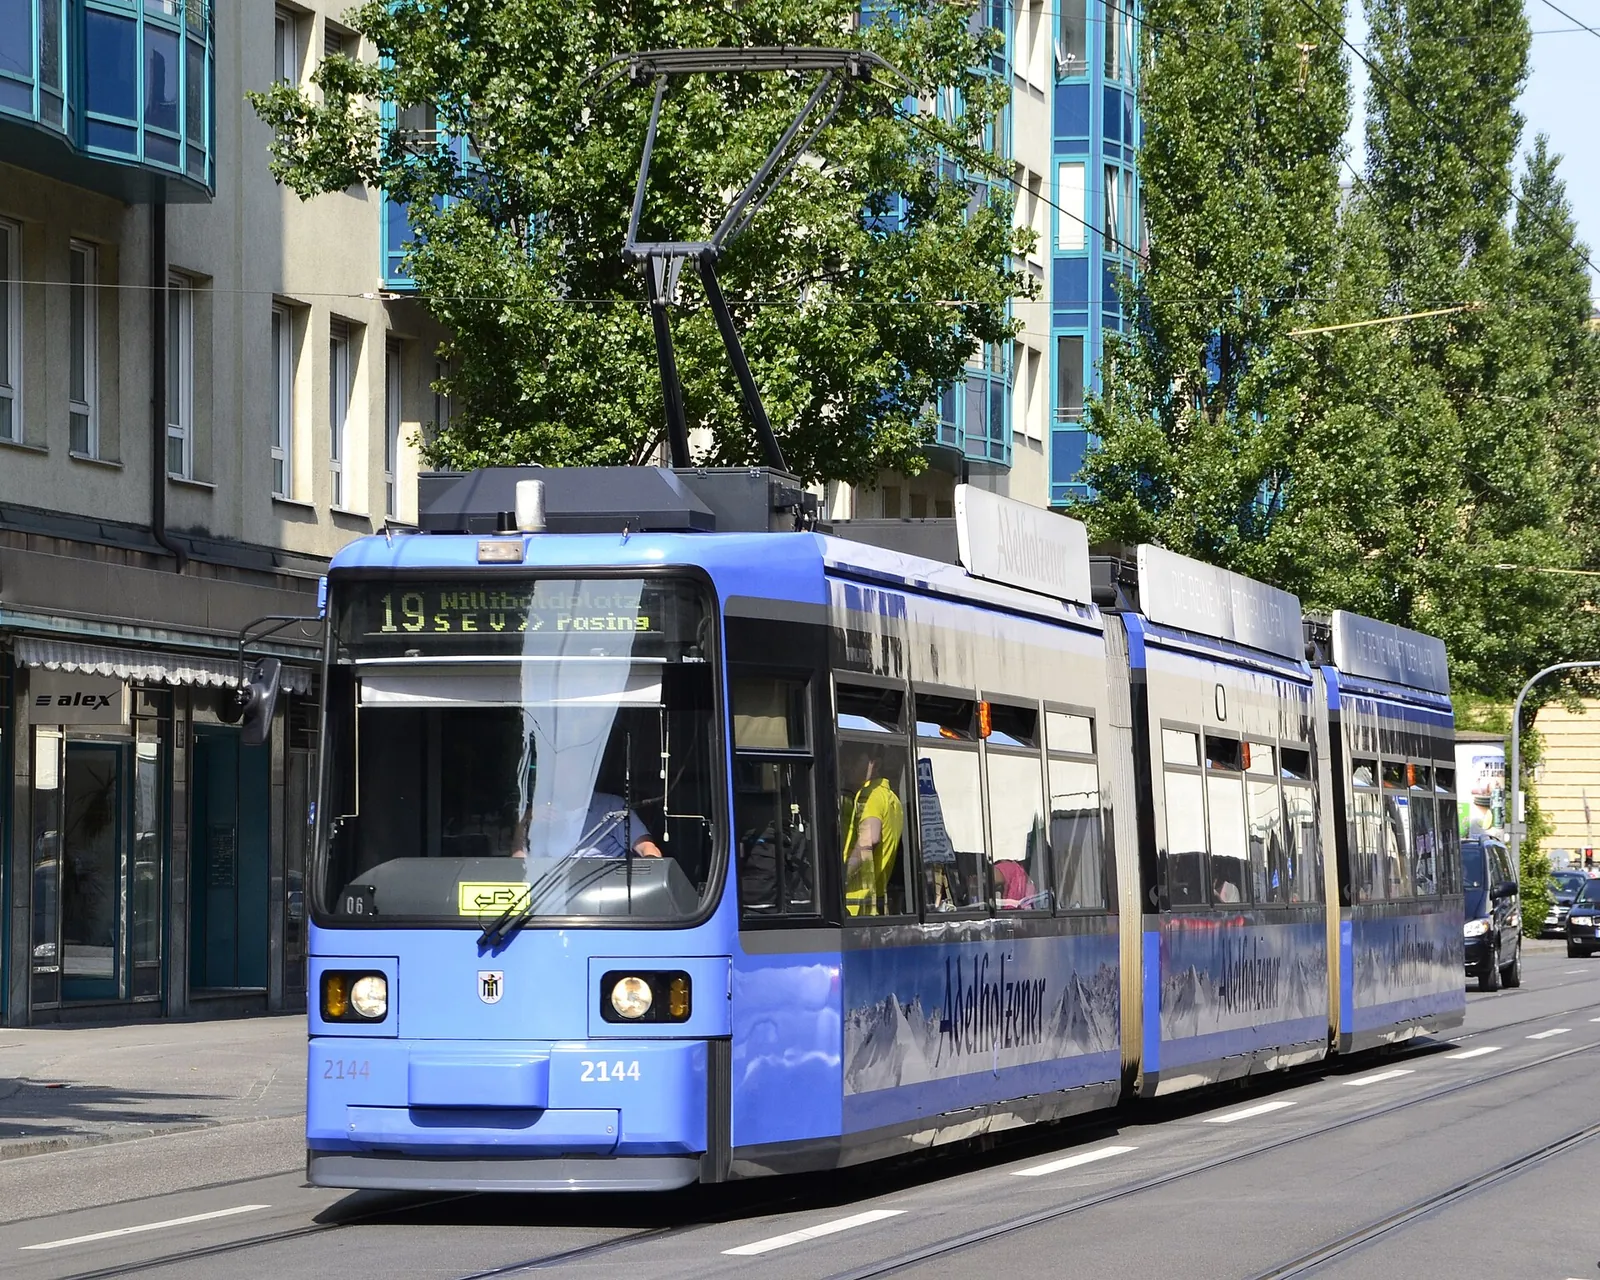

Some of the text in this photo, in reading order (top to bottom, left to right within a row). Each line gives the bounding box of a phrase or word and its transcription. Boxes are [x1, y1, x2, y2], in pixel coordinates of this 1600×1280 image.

[380, 592, 425, 632] 19
[557, 612, 650, 631] Pasing
[57, 689, 121, 711] alex
[346, 896, 363, 915] 06
[1217, 935, 1281, 1022] Adelholzener
[935, 951, 1046, 1068] Adelholzener
[323, 1060, 371, 1080] 2144
[580, 1060, 641, 1082] 2144
